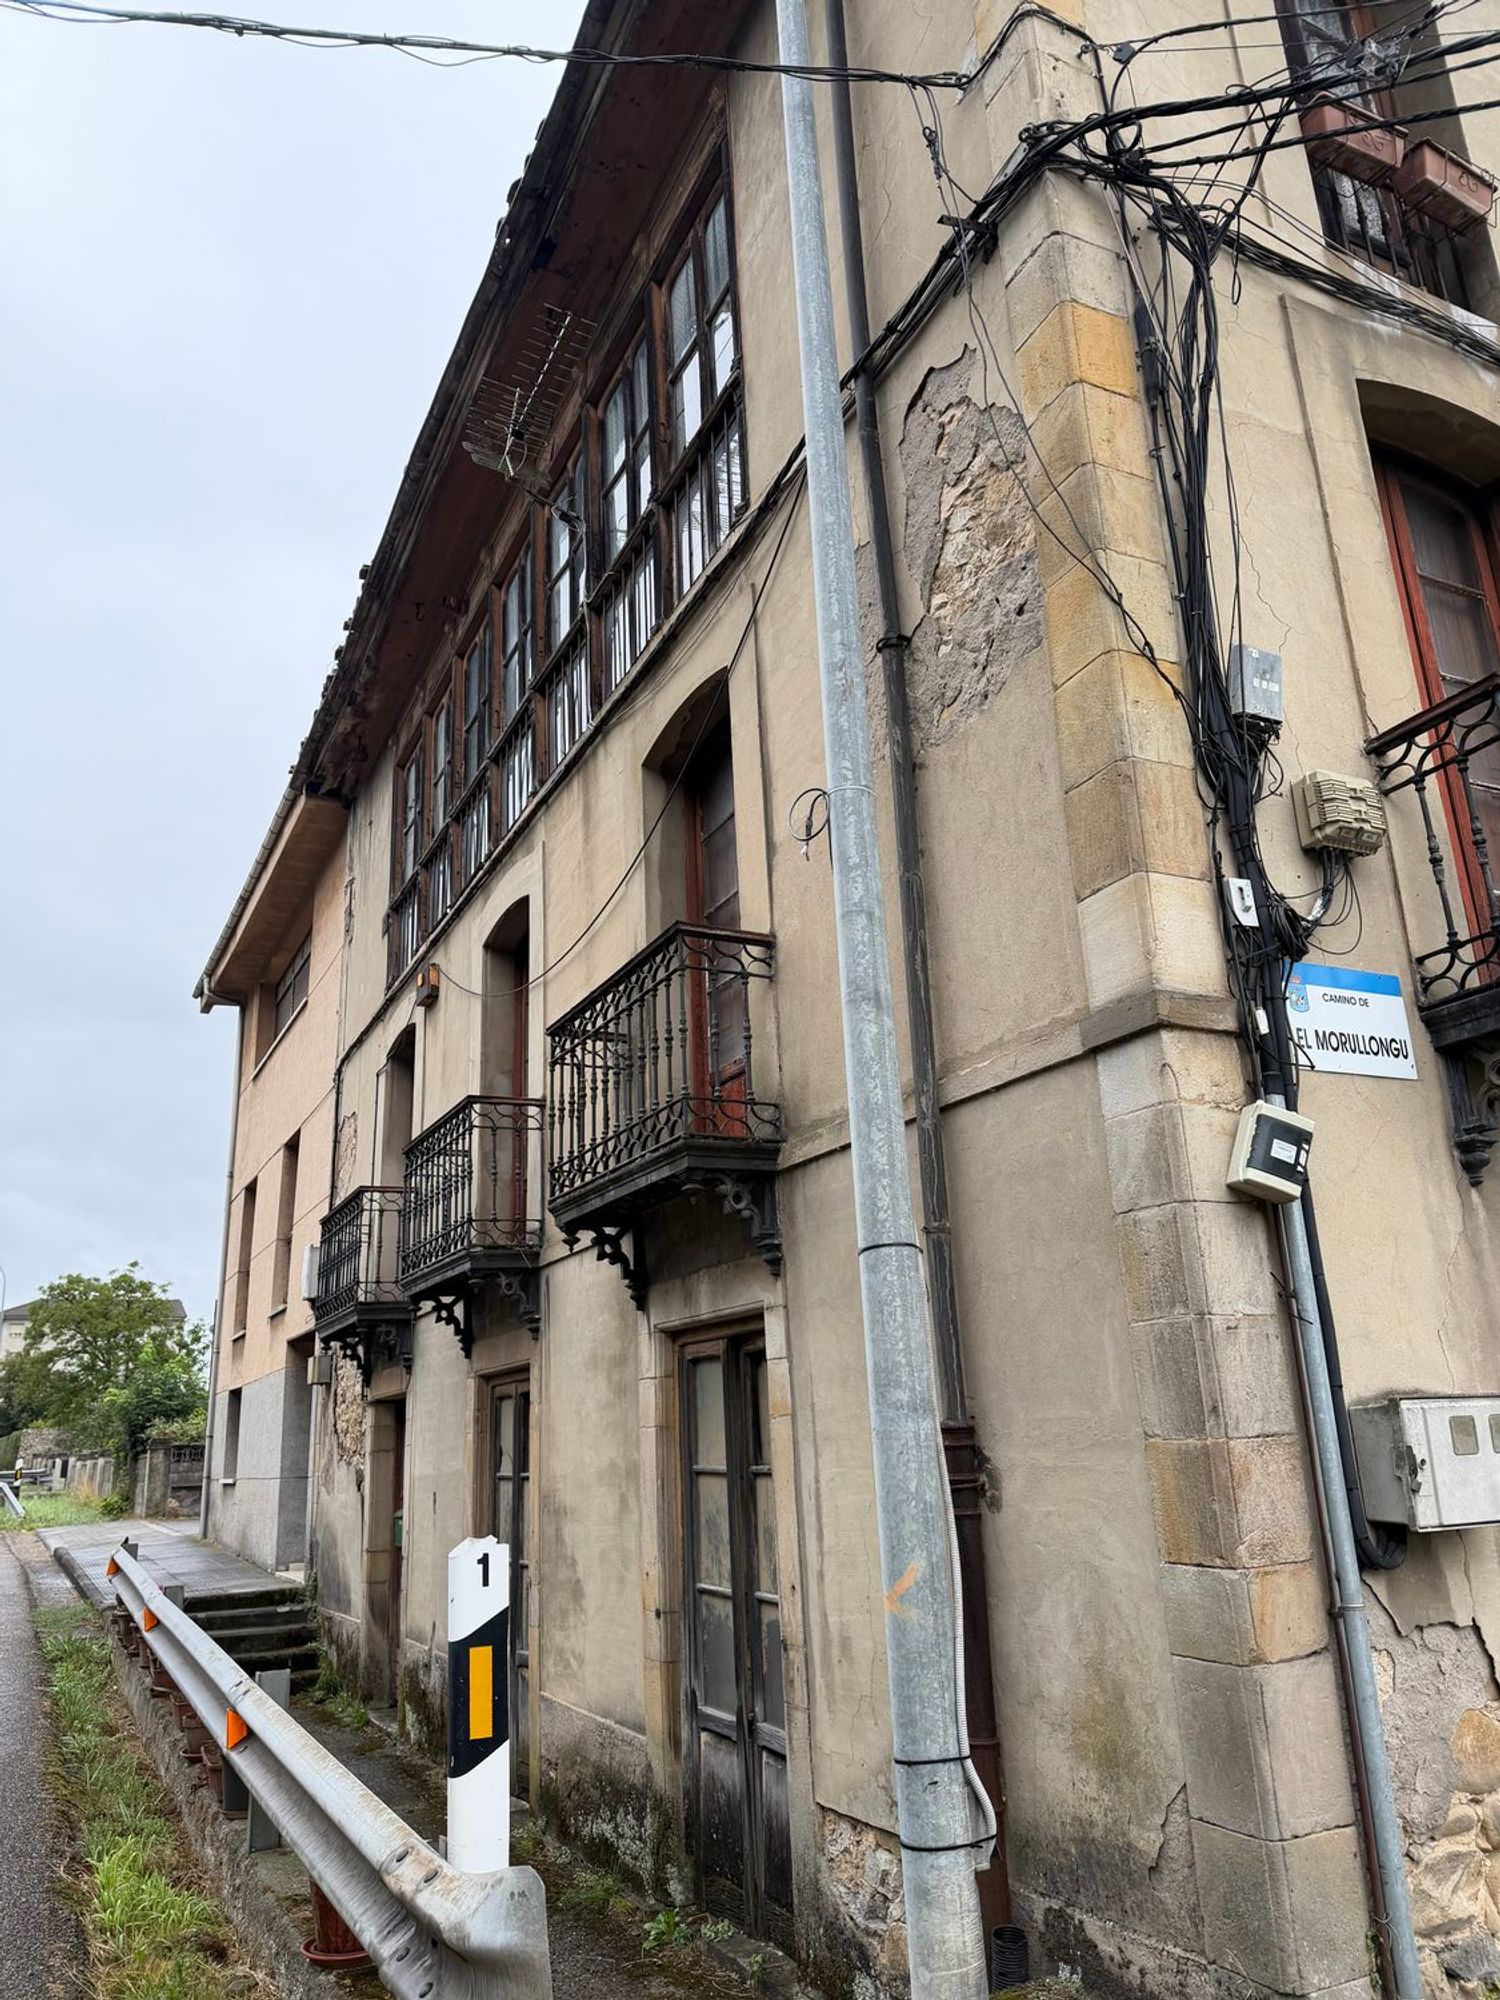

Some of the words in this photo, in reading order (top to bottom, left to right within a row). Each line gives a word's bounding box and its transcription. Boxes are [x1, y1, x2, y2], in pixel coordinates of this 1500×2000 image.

[1322, 993, 1357, 1006] CAMINO
[1359, 997, 1370, 1008] DE
[1296, 1027, 1312, 1049] EL
[1315, 1029, 1409, 1060] MORULLONGU
[477, 1553, 489, 1587] 1
